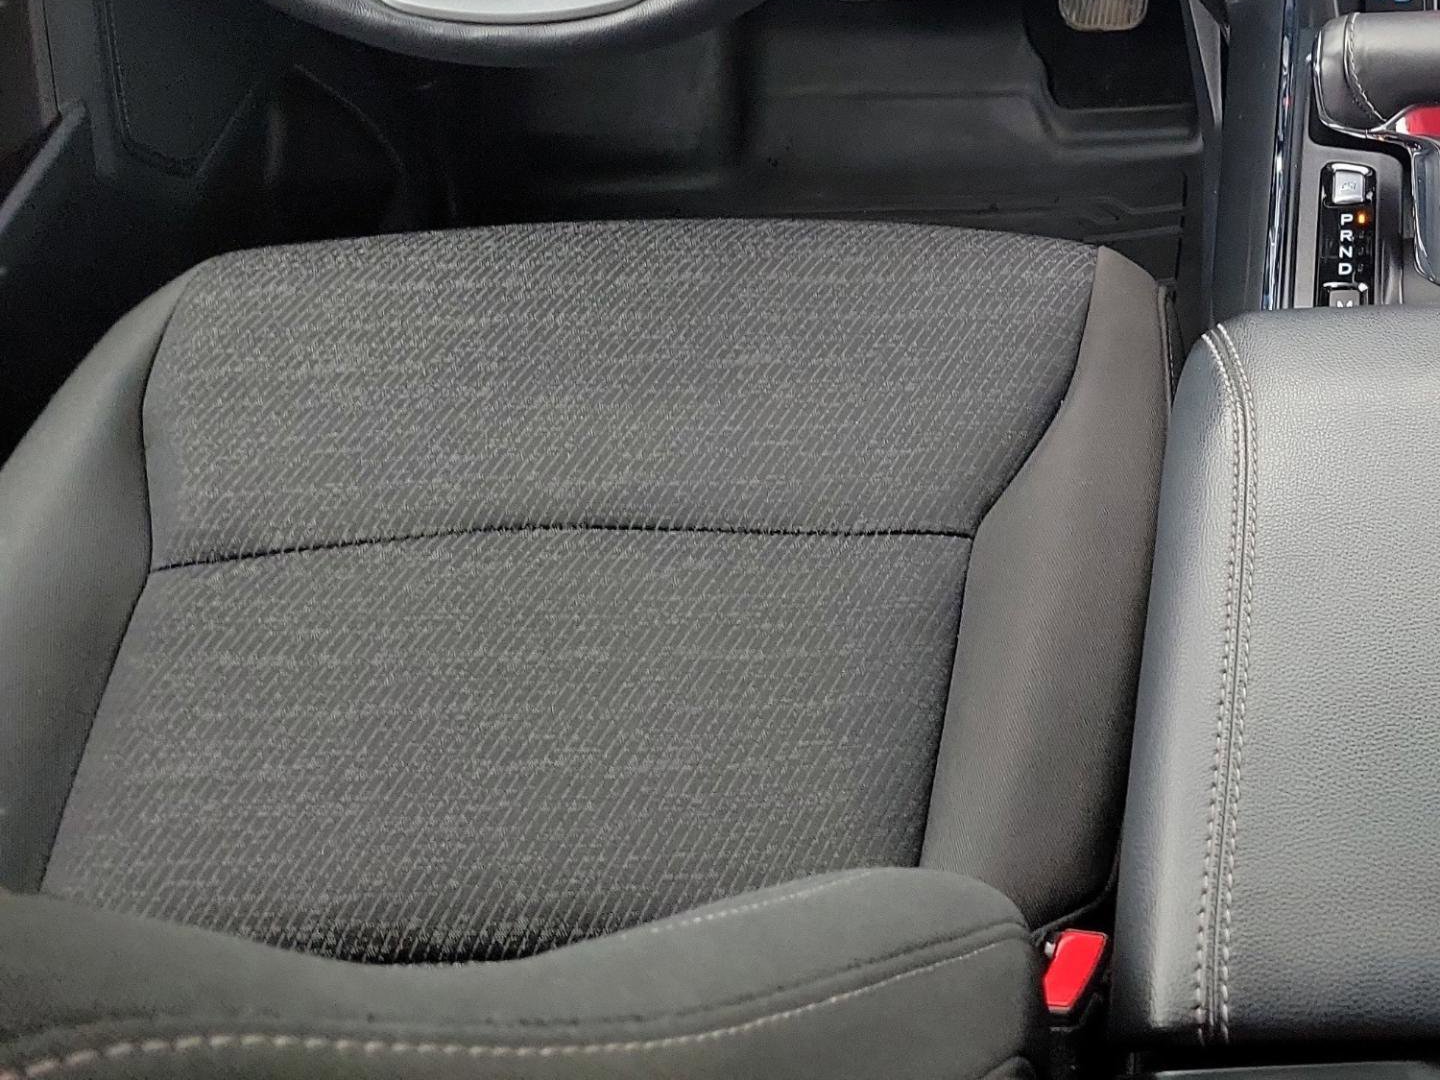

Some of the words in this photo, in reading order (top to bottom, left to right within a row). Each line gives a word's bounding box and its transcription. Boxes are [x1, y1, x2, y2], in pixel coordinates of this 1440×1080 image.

[1340, 213, 1353, 226] P
[1339, 230, 1353, 242] R
[1338, 245, 1353, 258] N
[1338, 262, 1352, 275] D
